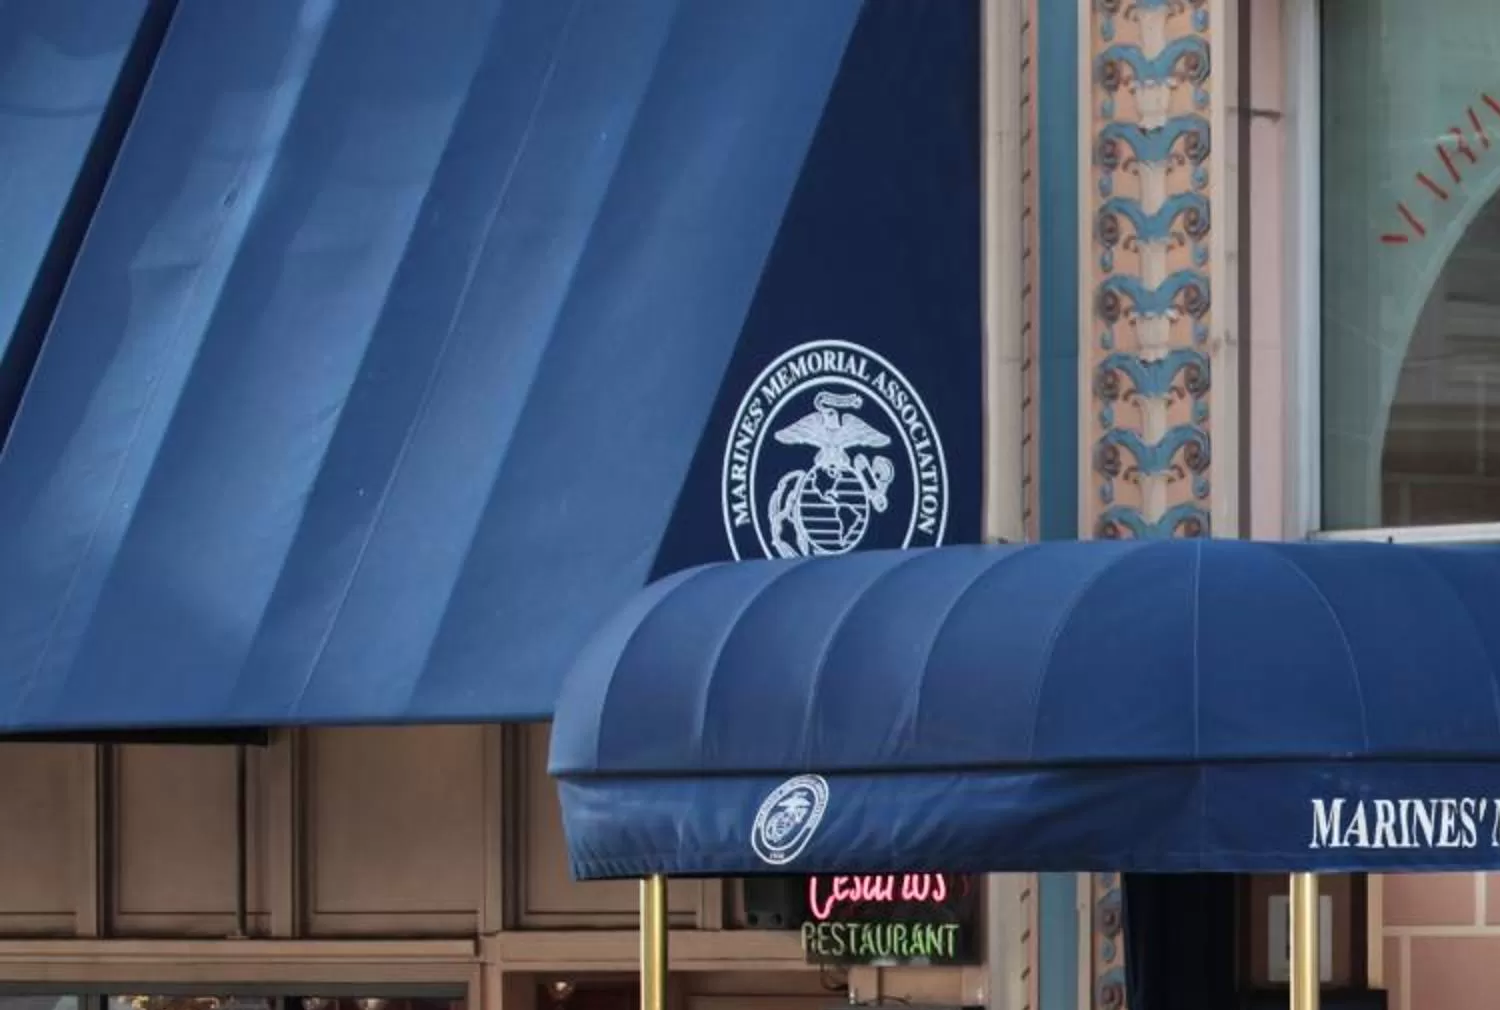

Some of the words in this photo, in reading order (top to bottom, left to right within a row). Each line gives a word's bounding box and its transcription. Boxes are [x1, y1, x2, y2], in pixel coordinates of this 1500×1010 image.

[761, 350, 870, 406] MEMORIAL
[872, 371, 940, 535] ASSOCIATION
[801, 921, 960, 957] RESTAURANT
